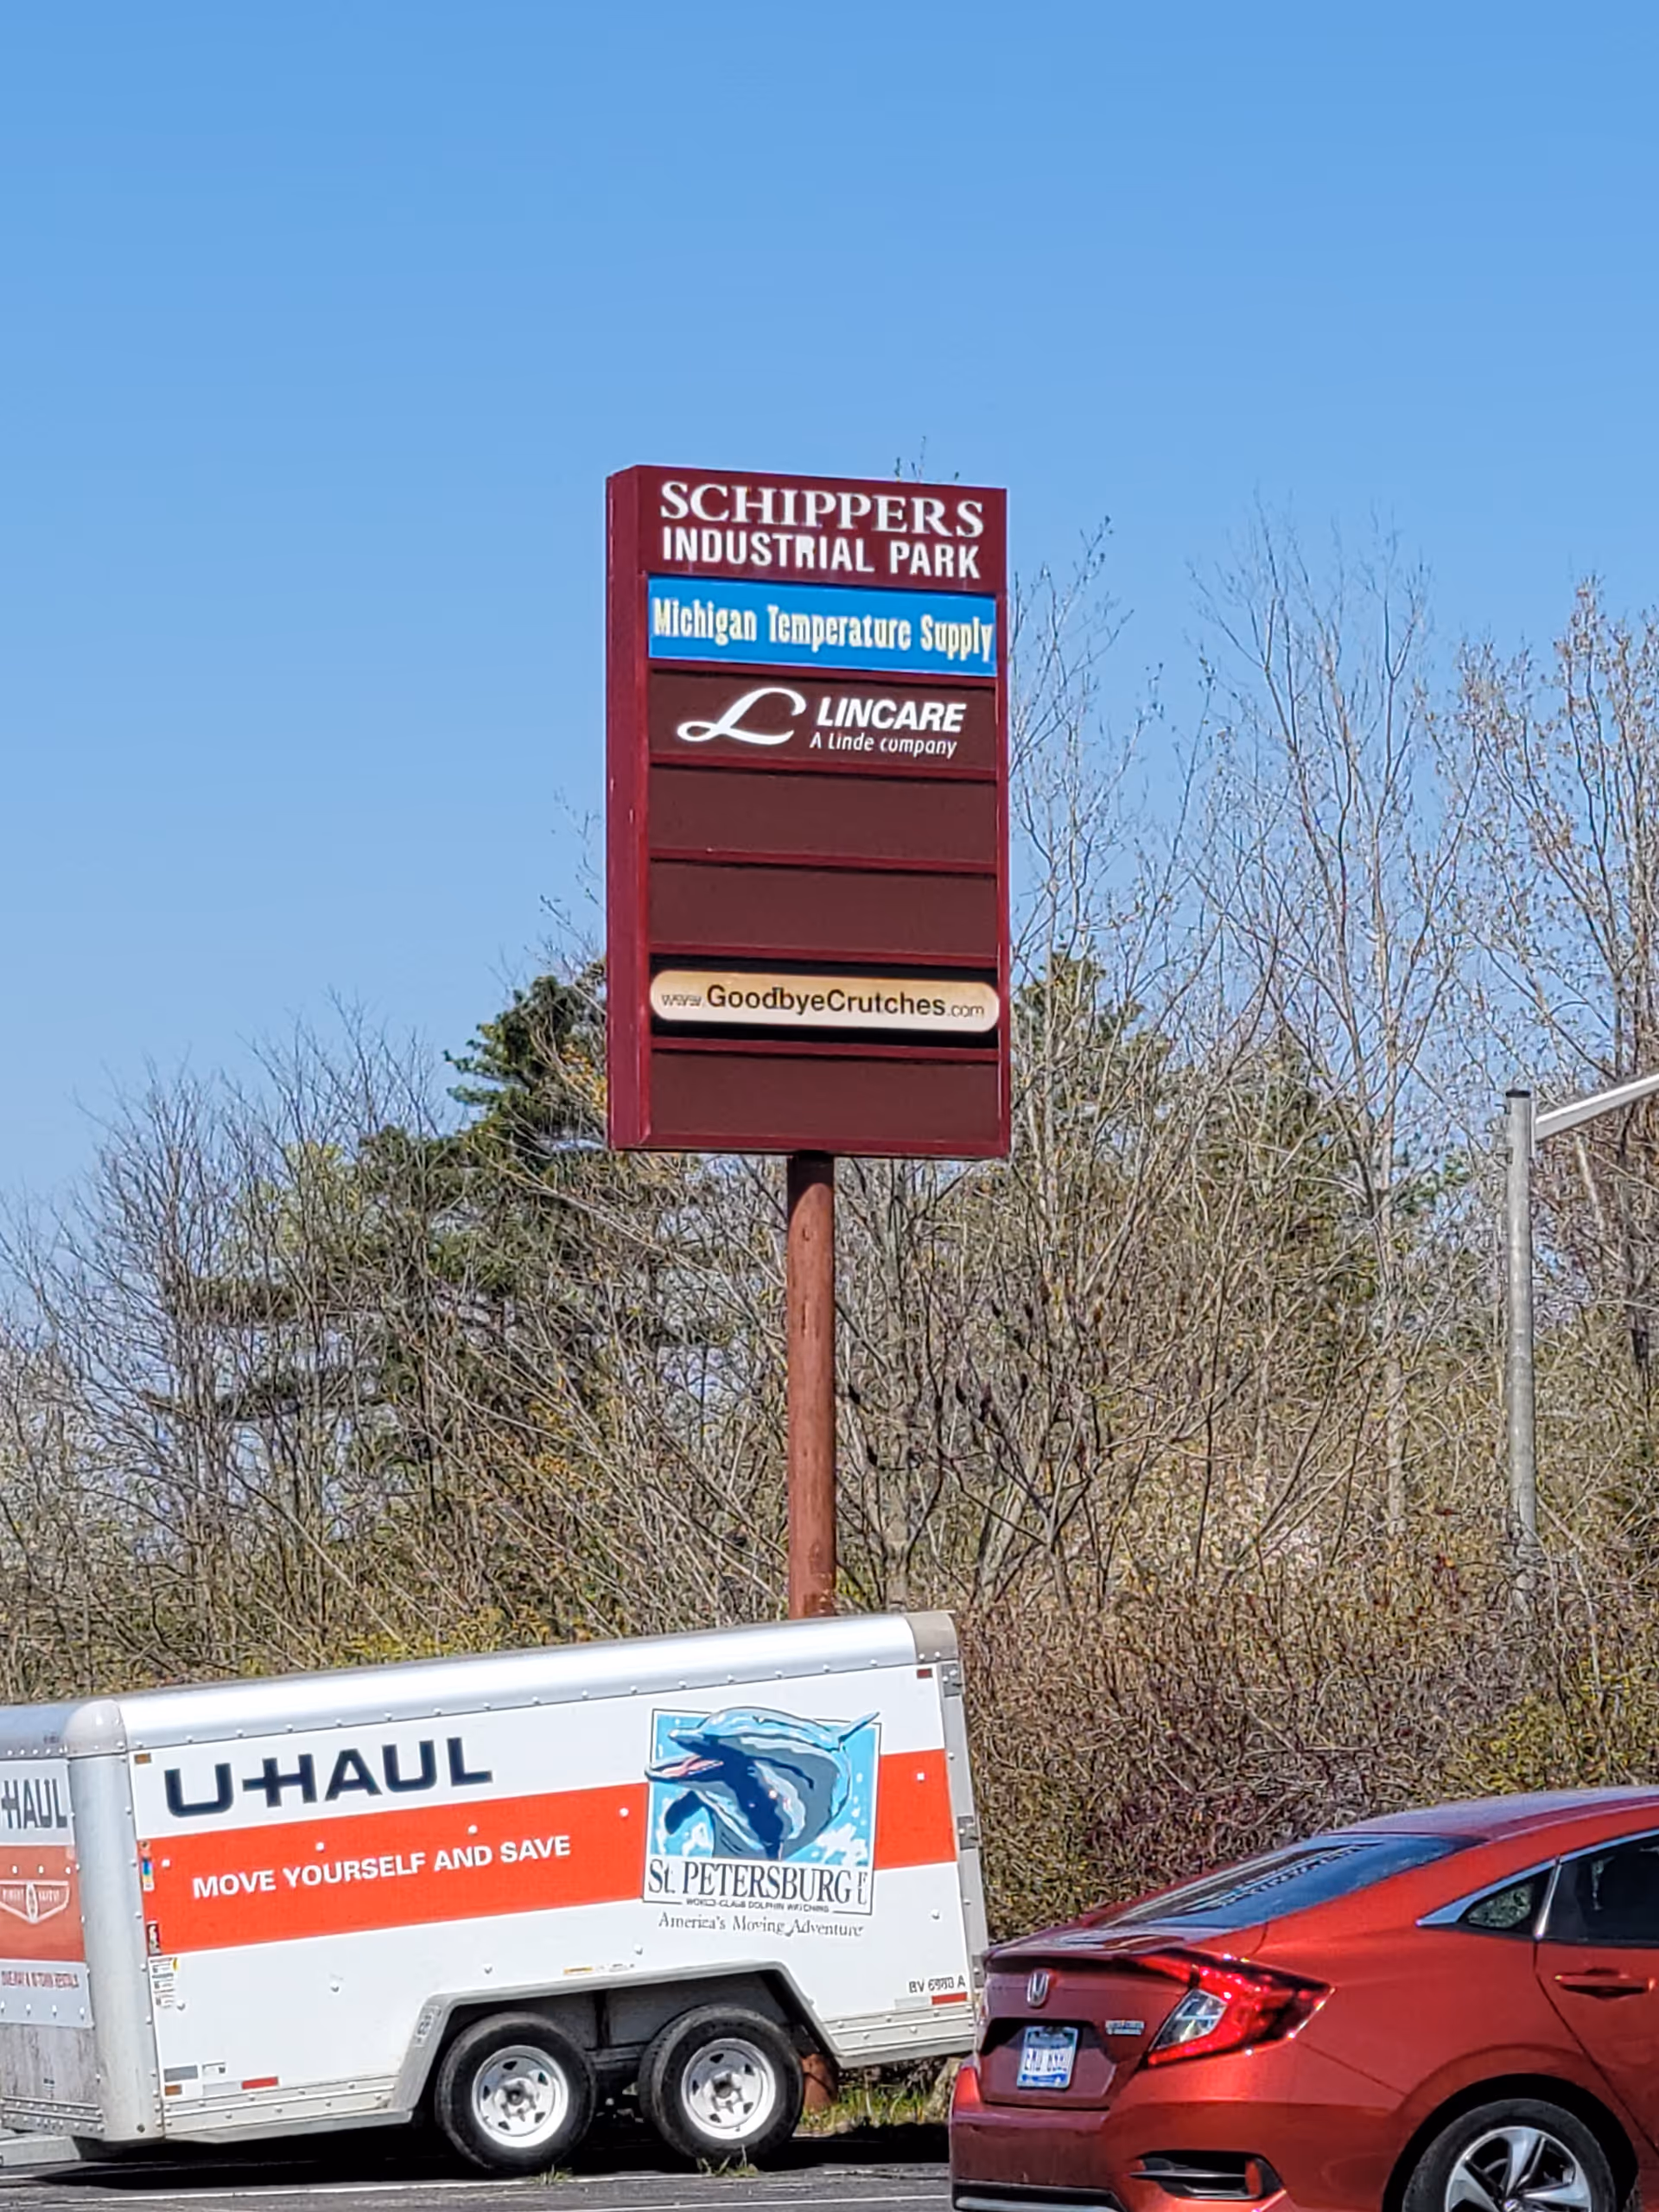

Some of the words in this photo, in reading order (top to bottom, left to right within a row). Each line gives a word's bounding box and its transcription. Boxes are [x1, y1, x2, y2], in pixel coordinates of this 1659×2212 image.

[660, 481, 984, 538] SCHIPPERS
[663, 527, 875, 573] INDUSTRIAL
[889, 540, 981, 579] PARK
[654, 599, 757, 645] Michigan
[767, 606, 912, 652] Temperature
[920, 614, 993, 663] Supply
[817, 697, 967, 732] LINCARE
[810, 733, 822, 749] A
[828, 733, 874, 752] Linde
[880, 736, 957, 759] company
[192, 1870, 276, 1900] MOVE
[282, 1852, 427, 1890] YOURSELF
[433, 1844, 494, 1872] AND
[499, 1834, 572, 1863] SAVE
[682, 1860, 852, 1904] PETERSBURG
[658, 1911, 726, 1930] America's
[733, 1916, 786, 1937] Moving
[957, 1974, 966, 1988] A
